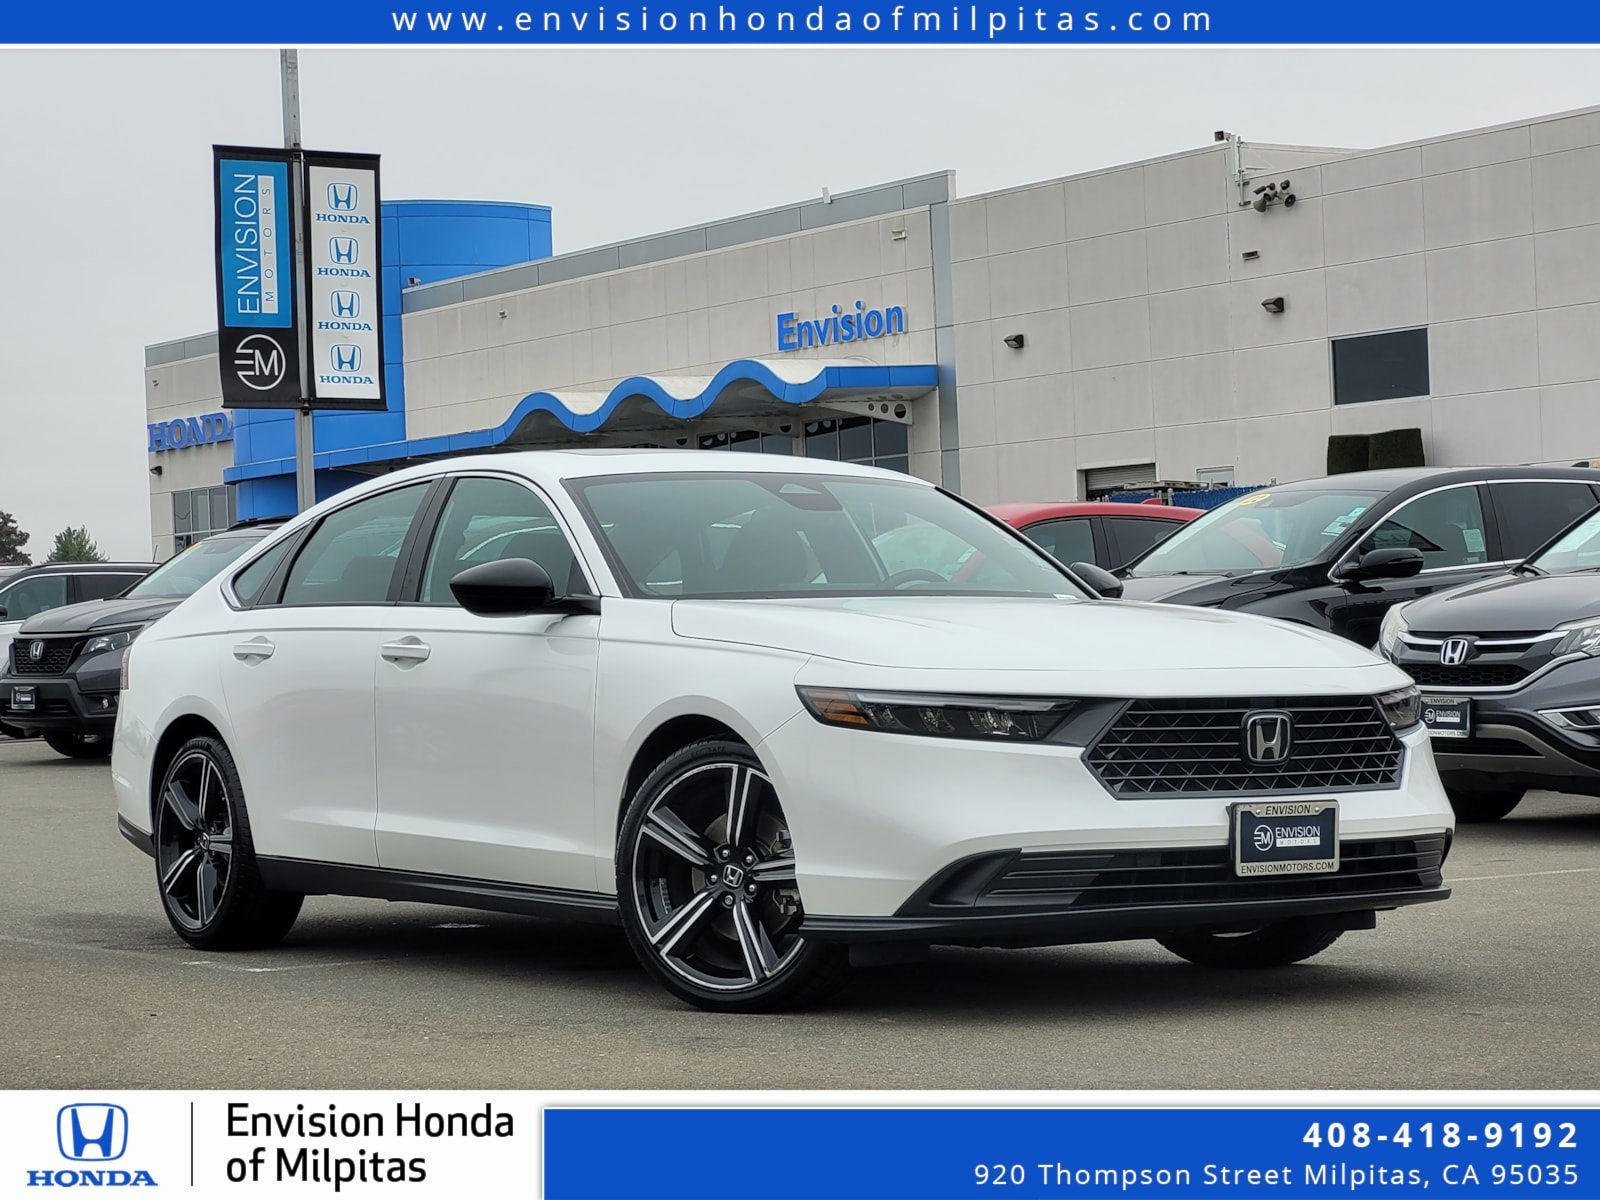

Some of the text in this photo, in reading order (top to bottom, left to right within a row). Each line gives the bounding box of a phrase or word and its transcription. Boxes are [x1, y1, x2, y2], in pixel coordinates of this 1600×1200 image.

[315, 213, 371, 225] HONDA
[234, 173, 260, 314] ENVISION
[262, 188, 275, 302] MOTORS
[317, 267, 371, 278] HONDA
[318, 321, 373, 332] HONDA
[777, 300, 904, 352] Envision
[320, 375, 374, 385] HONDA
[147, 412, 233, 453] HOND
[1265, 804, 1311, 816] ENVISION
[1275, 825, 1320, 839] ENVISION
[1241, 861, 1335, 875] ENVISIONMOTORS.COM
